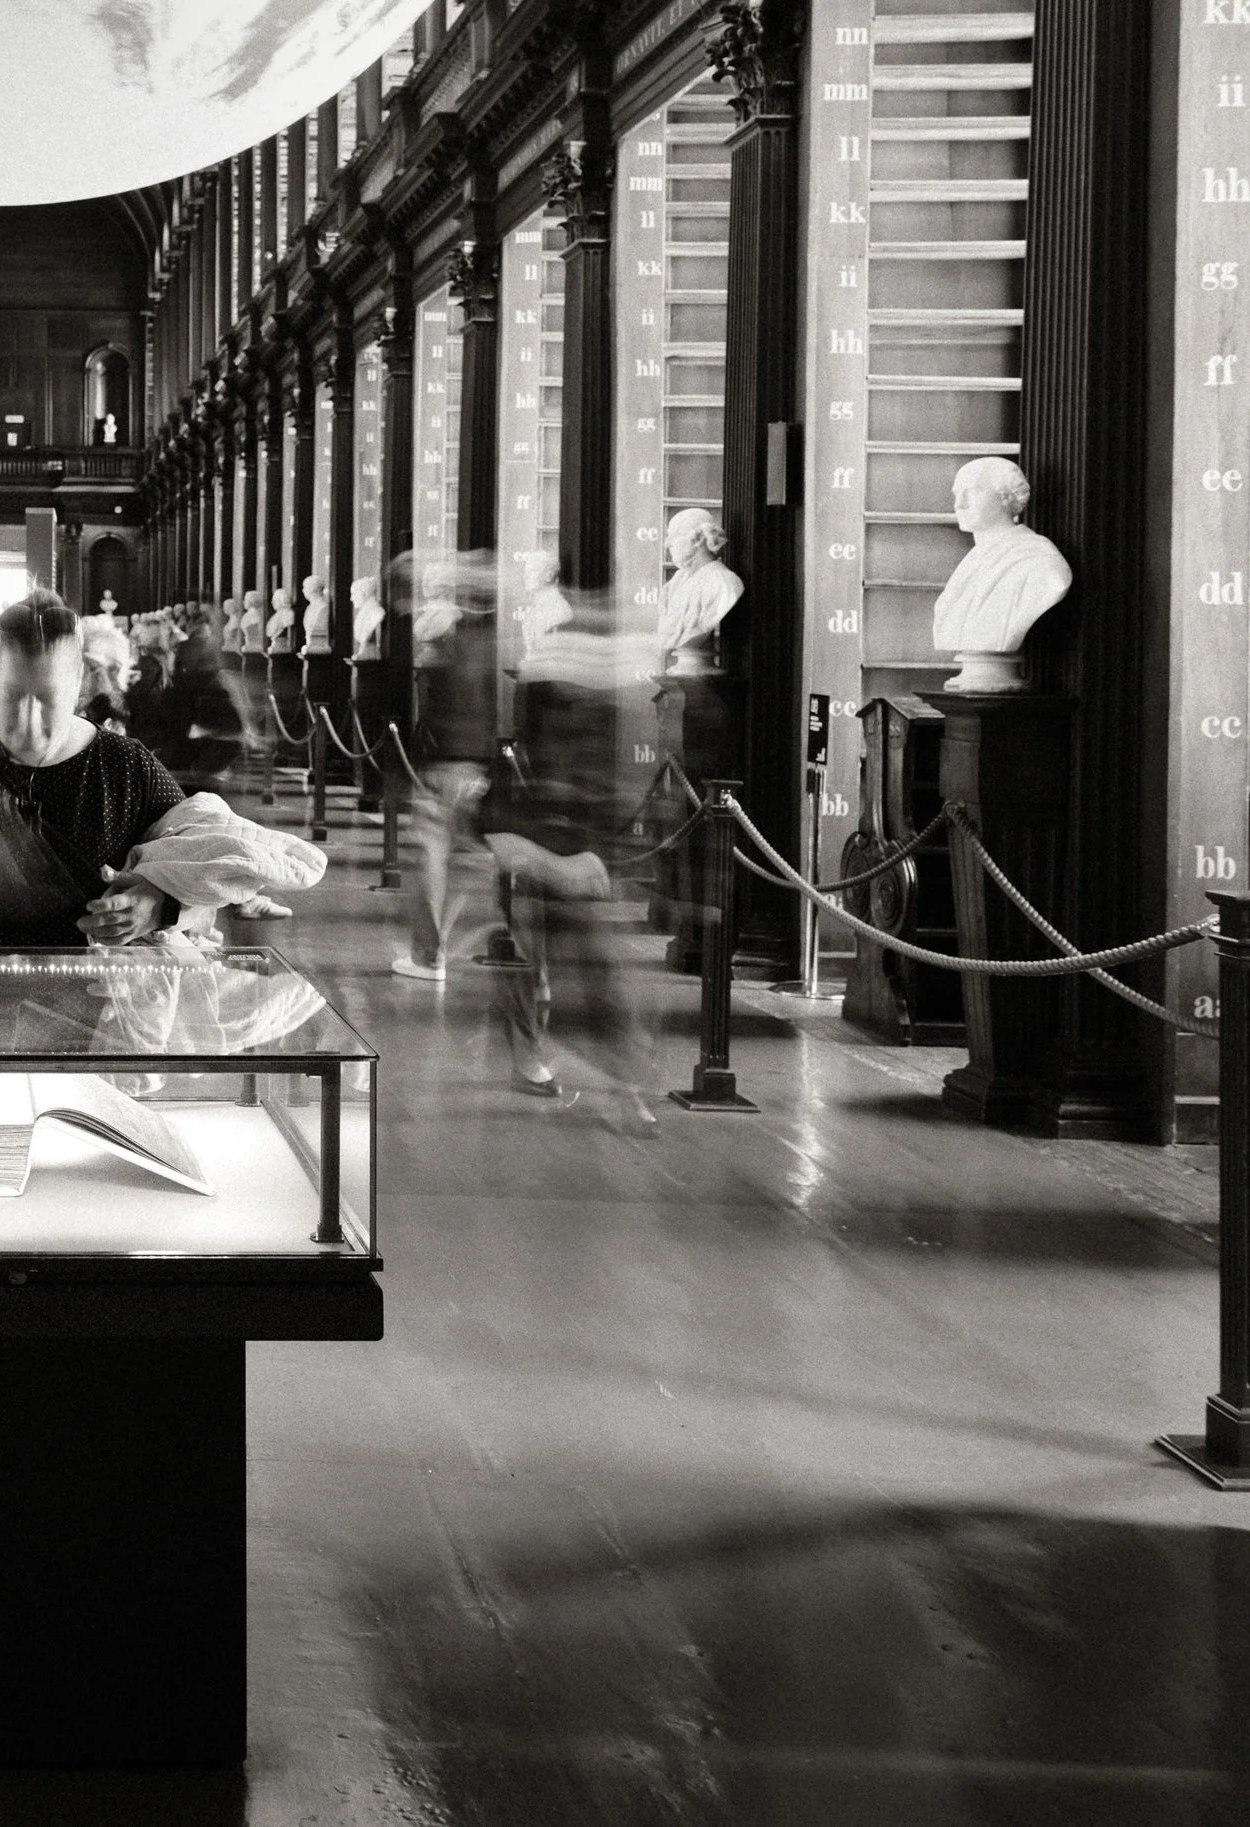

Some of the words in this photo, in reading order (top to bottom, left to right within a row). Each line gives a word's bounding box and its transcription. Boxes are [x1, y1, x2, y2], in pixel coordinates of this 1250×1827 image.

[836, 28, 868, 45] nn
[824, 84, 868, 100] mm
[1217, 75, 1245, 107] ii
[638, 142, 664, 155] nn
[838, 136, 860, 161] ll
[630, 175, 662, 191] mm
[1202, 167, 1250, 203] hh
[641, 211, 655, 228] ll
[830, 202, 866, 223] kk
[638, 260, 662, 275] kk
[840, 266, 857, 287] ii
[1202, 262, 1238, 290] gg
[516, 310, 537, 323] kk
[642, 309, 656, 325] ii
[831, 330, 863, 354] hh
[636, 359, 660, 376] hh
[1204, 355, 1237, 385] ff
[516, 393, 537, 409] hh
[830, 401, 854, 420] gg
[832, 467, 854, 488] ff
[1202, 468, 1242, 491] ee
[637, 527, 657, 541] ee
[829, 544, 856, 560] ee
[634, 587, 657, 604] dd
[1199, 571, 1243, 605] dd
[828, 610, 858, 633] dd
[829, 702, 856, 717] cc
[1201, 716, 1240, 738] cc
[634, 745, 655, 763] bb
[822, 794, 849, 816] bb
[1196, 845, 1236, 879] bb
[1194, 995, 1220, 1018] a
